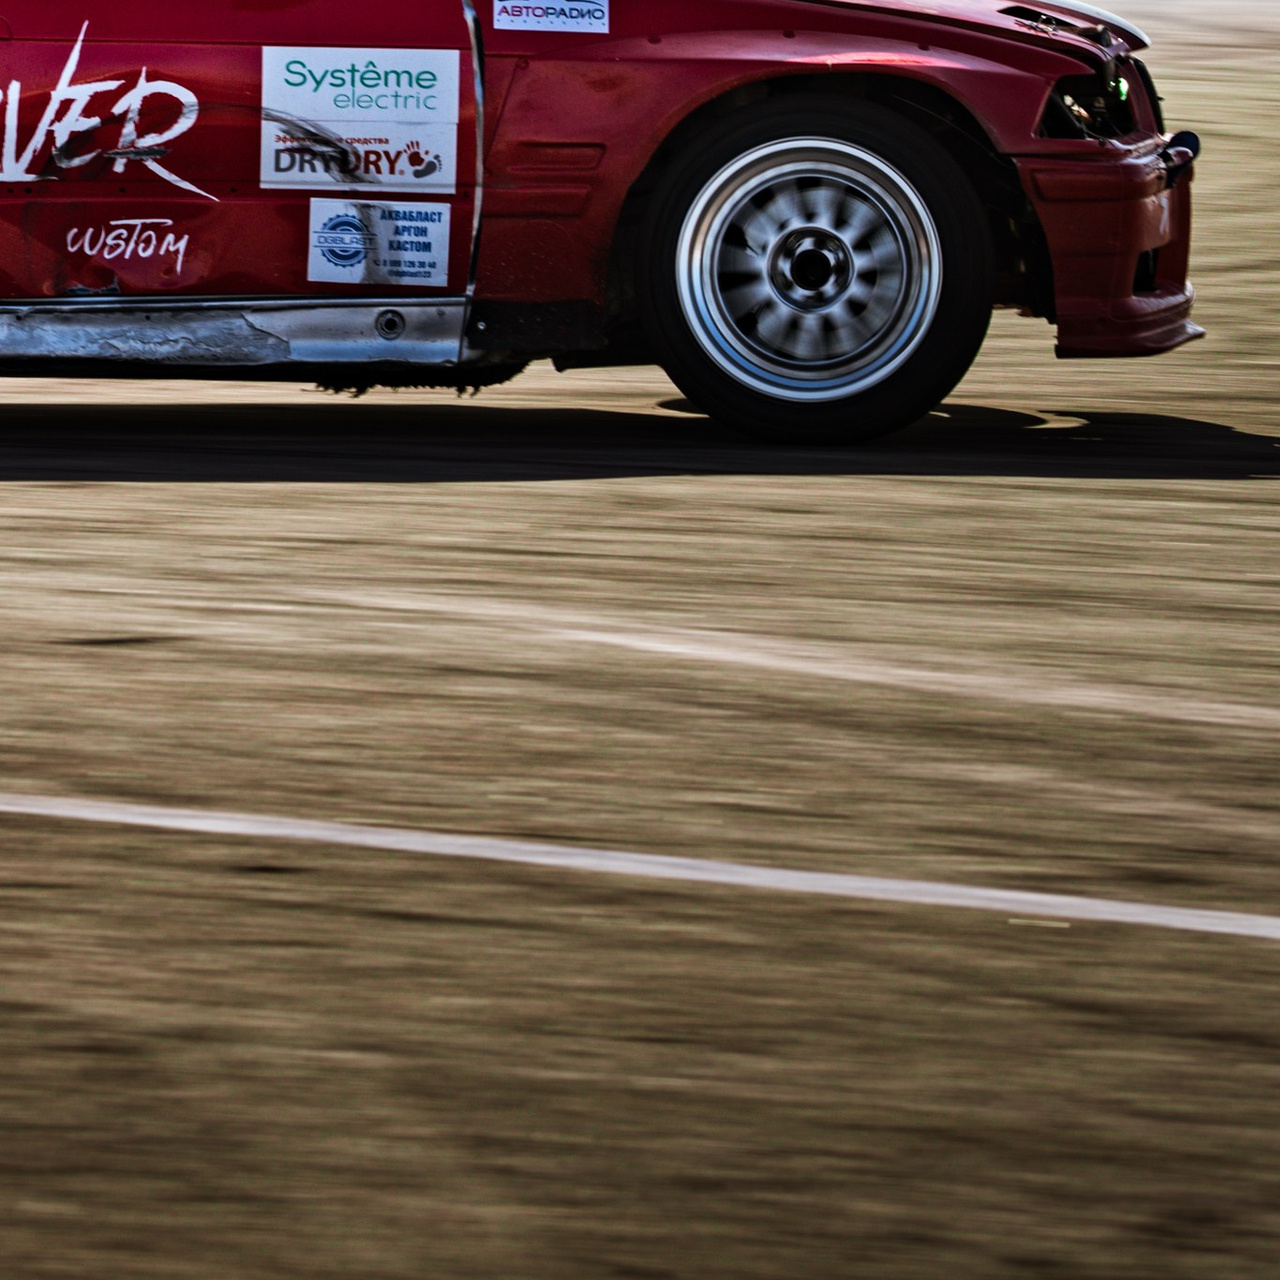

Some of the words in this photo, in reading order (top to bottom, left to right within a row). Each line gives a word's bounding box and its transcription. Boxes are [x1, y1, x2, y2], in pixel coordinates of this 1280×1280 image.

[284, 60, 438, 93] Systême
[333, 88, 438, 110] electric
[380, 209, 443, 223] АКВАБЛАСТ
[393, 225, 428, 237] АРГОН
[66, 219, 190, 276] CUSTOM
[388, 240, 432, 253] КАСТОМ
